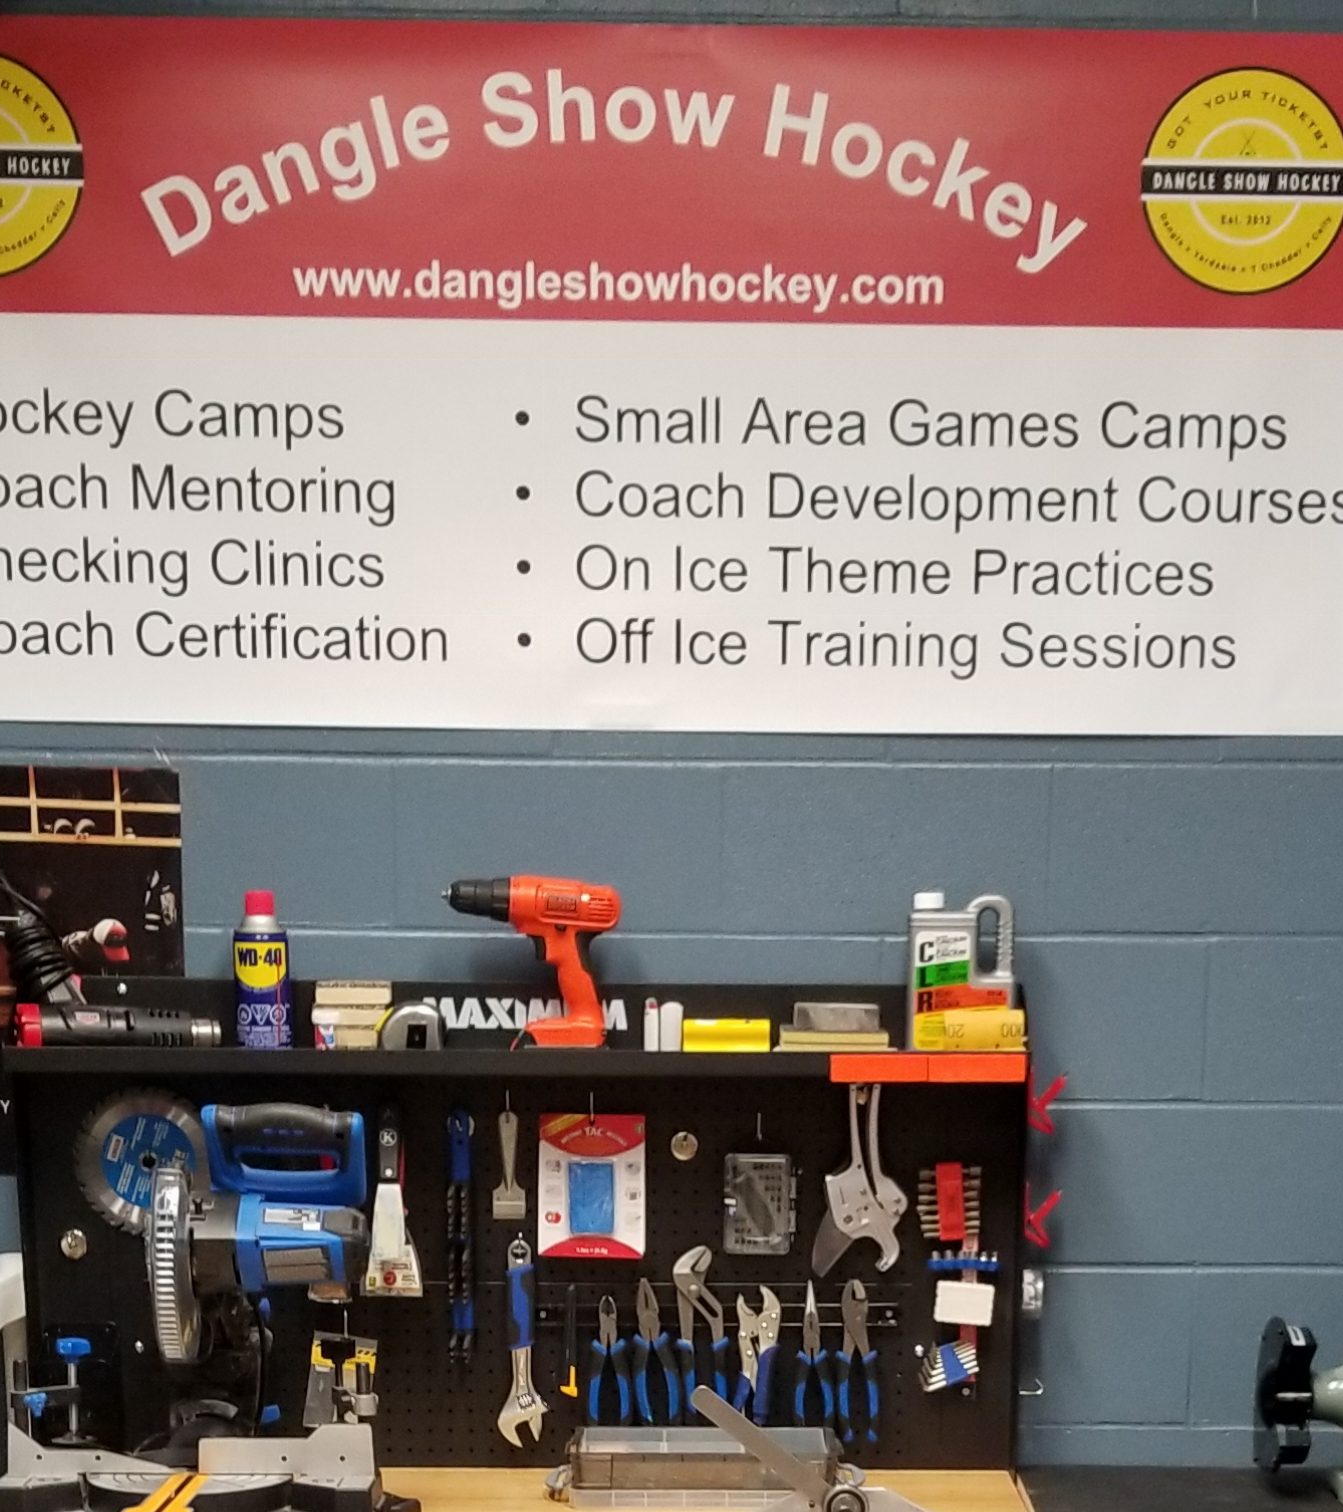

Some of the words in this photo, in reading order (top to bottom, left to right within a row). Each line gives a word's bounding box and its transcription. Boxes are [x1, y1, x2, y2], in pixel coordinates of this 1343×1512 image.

[1167, 115, 1193, 150] GOT
[1203, 89, 1252, 110] YOUR
[7, 156, 71, 177] HOCKEY
[138, 95, 451, 257] Dangle
[481, 68, 735, 148] Show
[763, 83, 1087, 275] Hockey
[1152, 171, 1216, 191] DANGLE
[1223, 172, 1270, 192] SHOW
[1277, 172, 1342, 193] HOCKEY
[1246, 214, 1272, 226] 2012
[293, 260, 945, 313] www.dangleshowhockey.com
[154, 389, 345, 450] Camps
[575, 395, 721, 445] Small
[741, 398, 866, 447] Area
[889, 399, 1080, 449] Games
[1100, 401, 1287, 461] Camps
[131, 463, 396, 527] Mentoring
[575, 470, 745, 519] Coach
[768, 472, 1119, 532] Development
[210, 538, 385, 589] Clinics
[575, 544, 650, 591] On
[674, 545, 748, 594] Ice
[768, 546, 951, 596] Theme
[973, 549, 1214, 597] Practices
[135, 611, 449, 662] Certification
[575, 617, 655, 666] Off
[674, 618, 747, 666] Ice
[768, 620, 978, 679] Training
[1000, 621, 1237, 670] Sessions
[918, 967, 935, 988] L
[919, 941, 935, 963] C
[422, 996, 628, 1031] MAXIMM
[917, 991, 934, 1014] R
[584, 1126, 604, 1137] TAC
